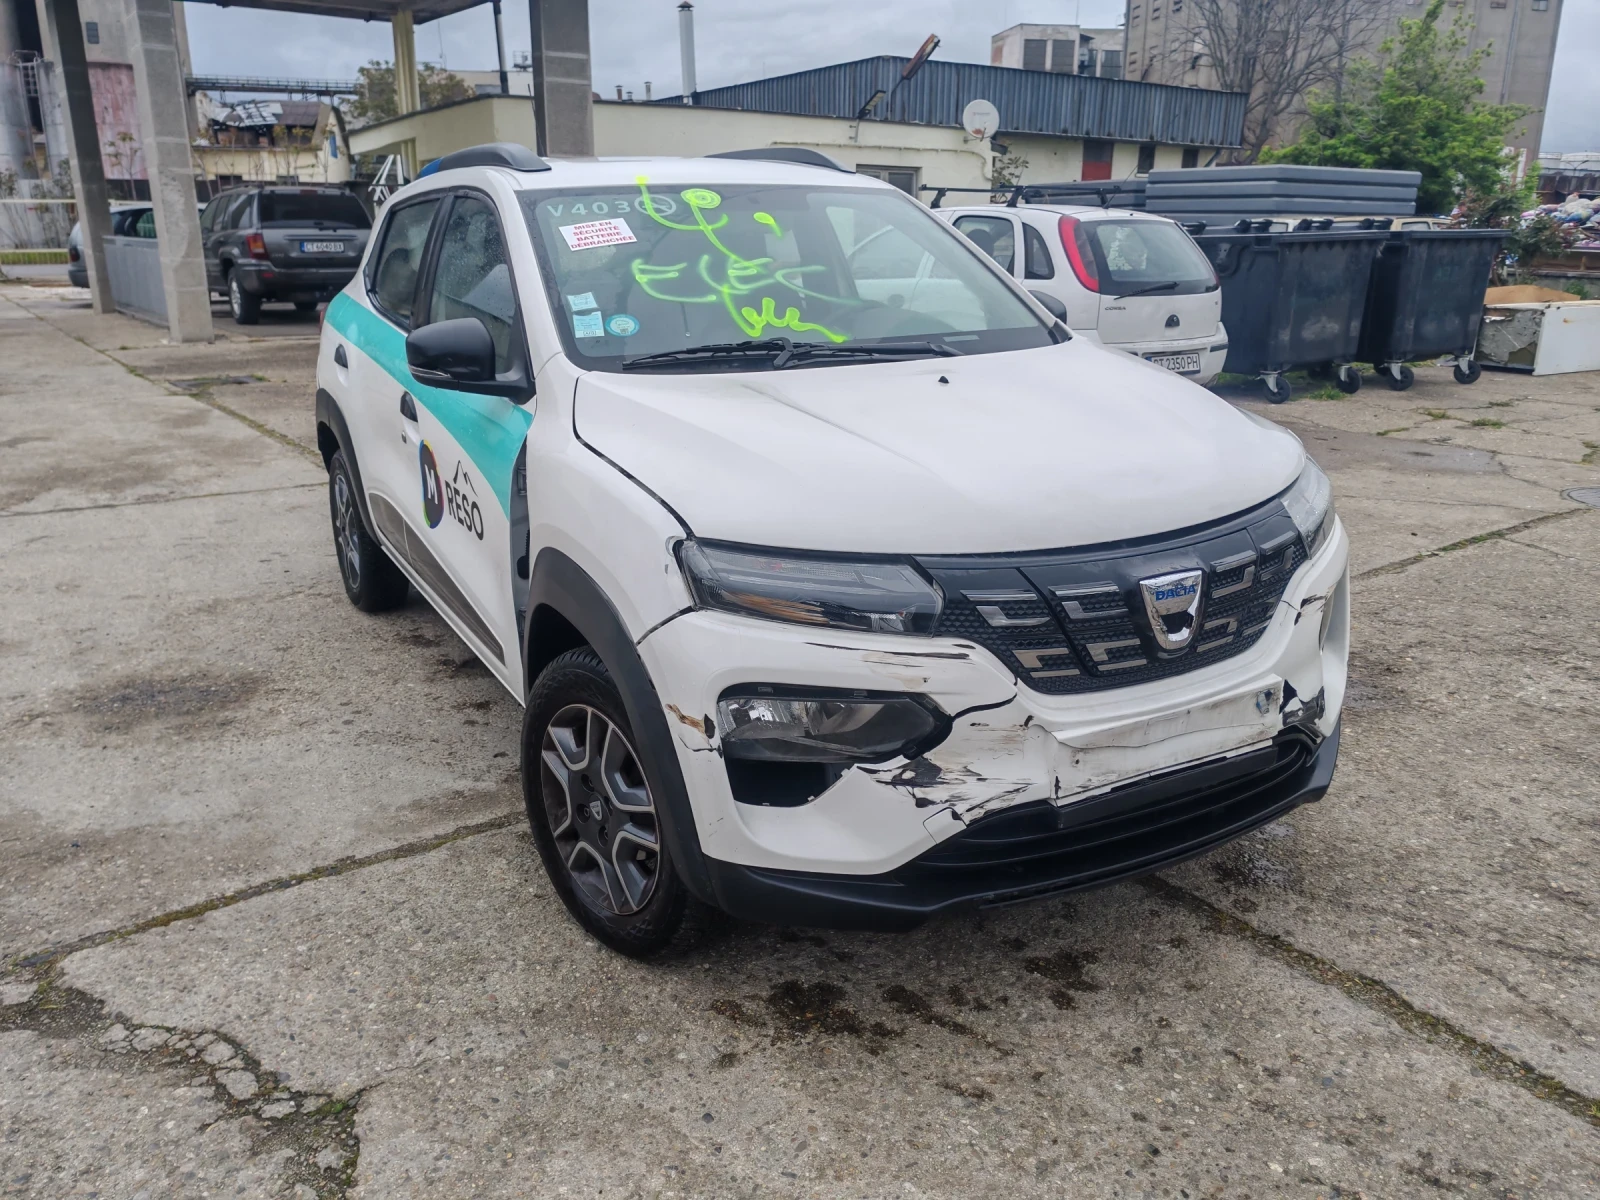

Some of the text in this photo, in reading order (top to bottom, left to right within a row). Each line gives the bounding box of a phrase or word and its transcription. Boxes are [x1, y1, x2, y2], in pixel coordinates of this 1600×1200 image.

[547, 201, 631, 217] V403
[572, 225, 620, 237] SÉCURITÉ
[573, 223, 597, 231] MISE
[570, 235, 635, 249] DÉBRANCHÉE
[576, 231, 623, 242] BATTERIE
[1165, 356, 1186, 371] 2350
[1186, 355, 1199, 369] PH
[445, 479, 484, 541] RESO
[1155, 584, 1196, 602] DACIA
